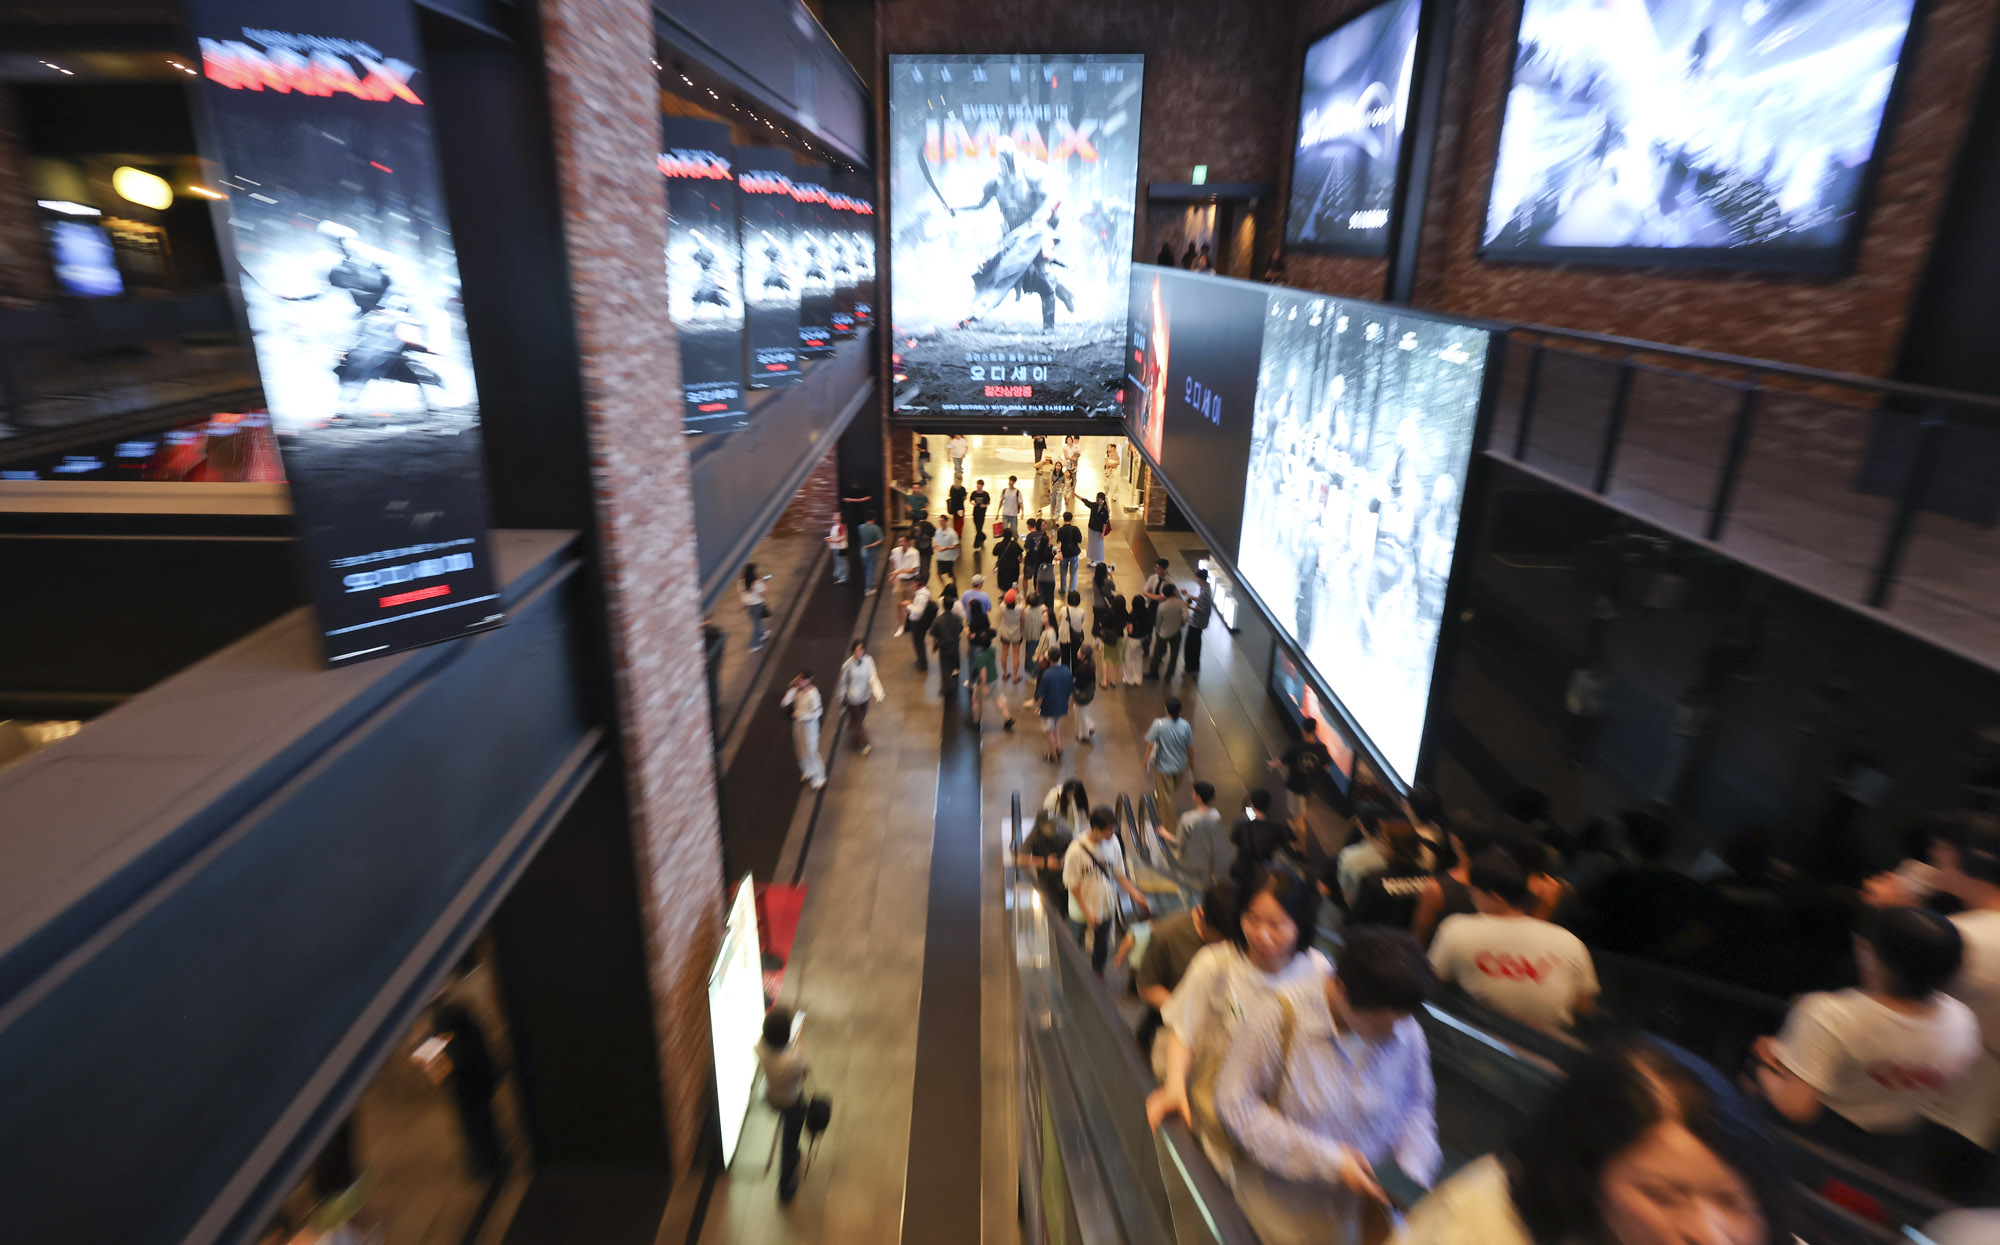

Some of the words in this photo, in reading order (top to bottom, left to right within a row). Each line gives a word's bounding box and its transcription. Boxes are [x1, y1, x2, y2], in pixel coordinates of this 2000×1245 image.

[962, 103, 1003, 121] EVERY
[1007, 103, 1051, 121] FRAME
[1056, 103, 1068, 121] IN
[925, 118, 1099, 163] IMAX
[970, 365, 1047, 381] 오디세이
